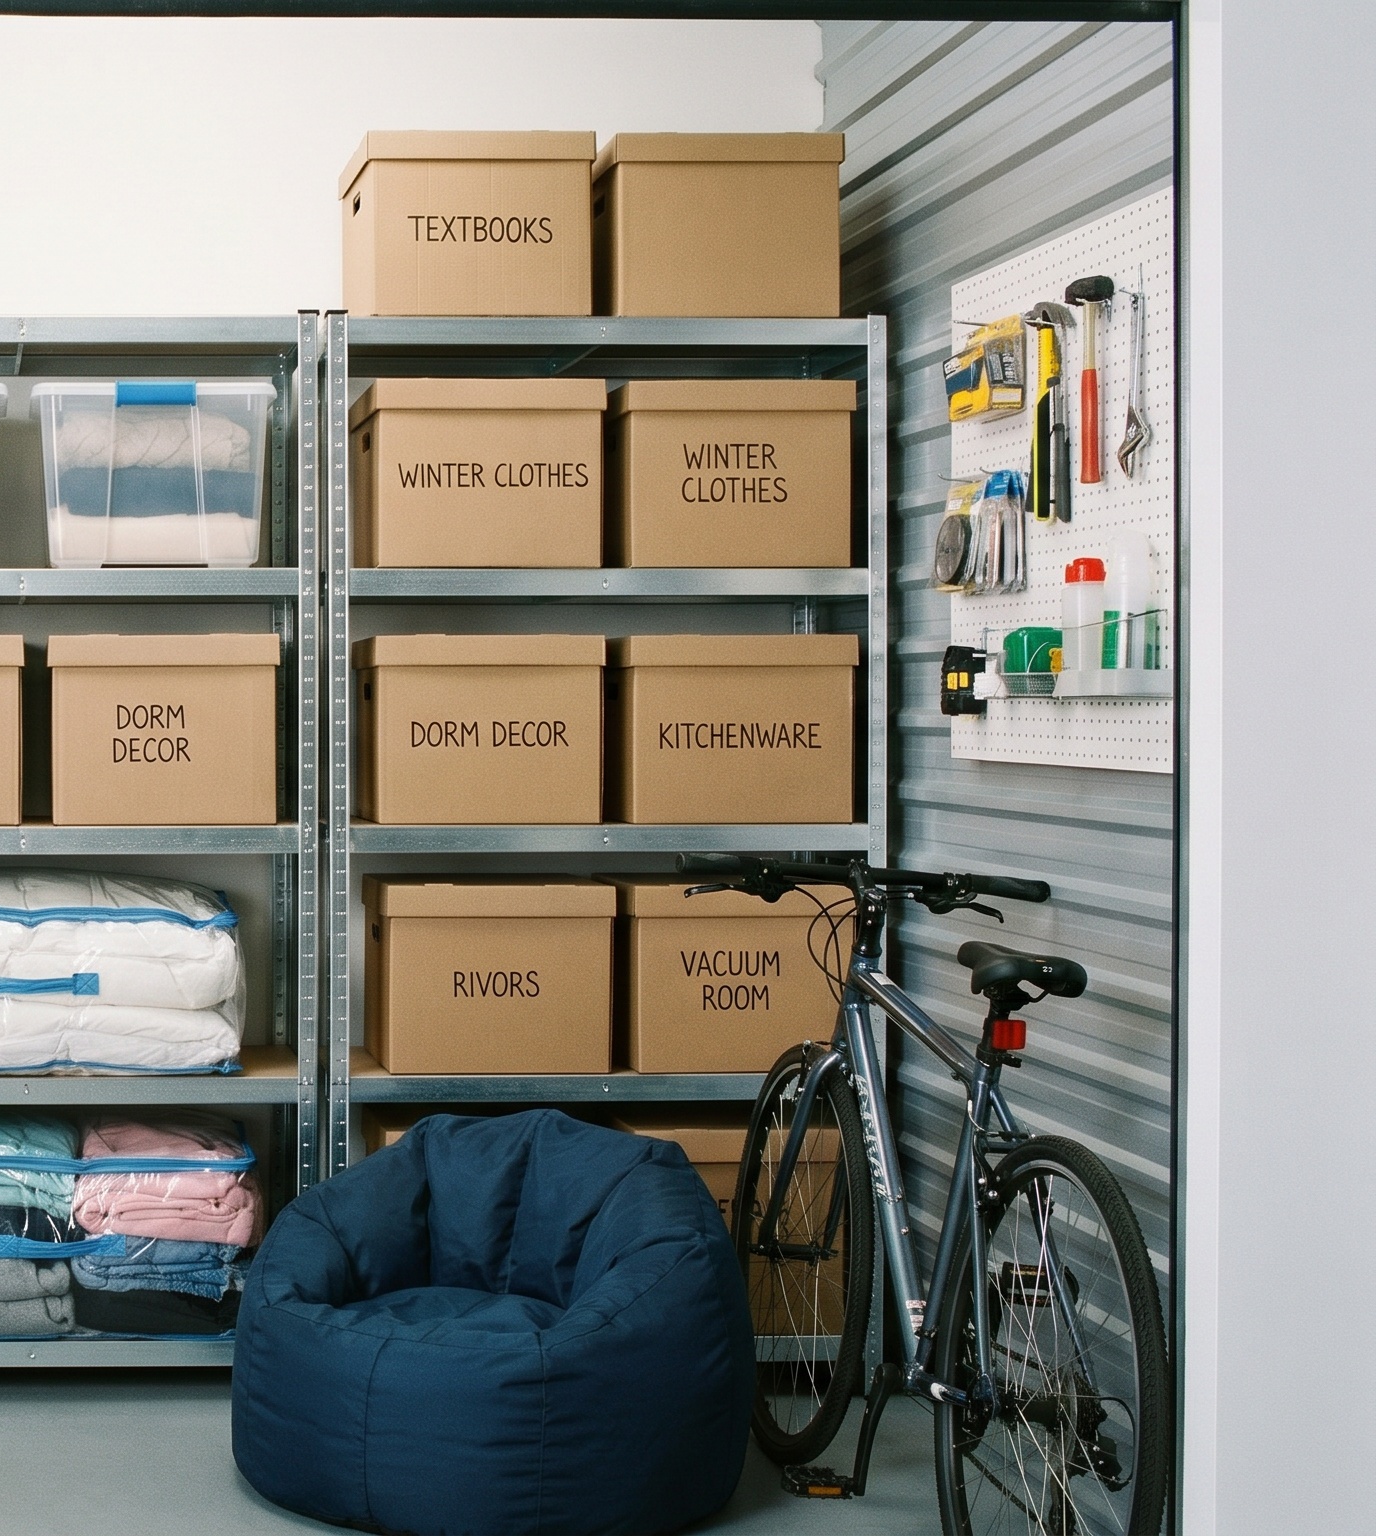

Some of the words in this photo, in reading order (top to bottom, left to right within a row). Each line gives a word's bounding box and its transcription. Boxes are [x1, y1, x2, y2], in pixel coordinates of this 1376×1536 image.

[408, 216, 554, 244] TEXTBOOKS
[683, 443, 778, 470] WINTER
[398, 463, 486, 489] WINTER
[495, 463, 589, 489] CLOTHES
[682, 476, 788, 504] CLOTHES
[116, 704, 186, 730] DORM
[411, 720, 480, 748] DORM
[492, 720, 570, 748] DECOR
[659, 722, 822, 750] KITCHENWARE
[112, 736, 192, 764] DECOR
[680, 950, 781, 977] VACUUM
[453, 970, 540, 998] RIVORS
[702, 984, 770, 1011] ROOM
